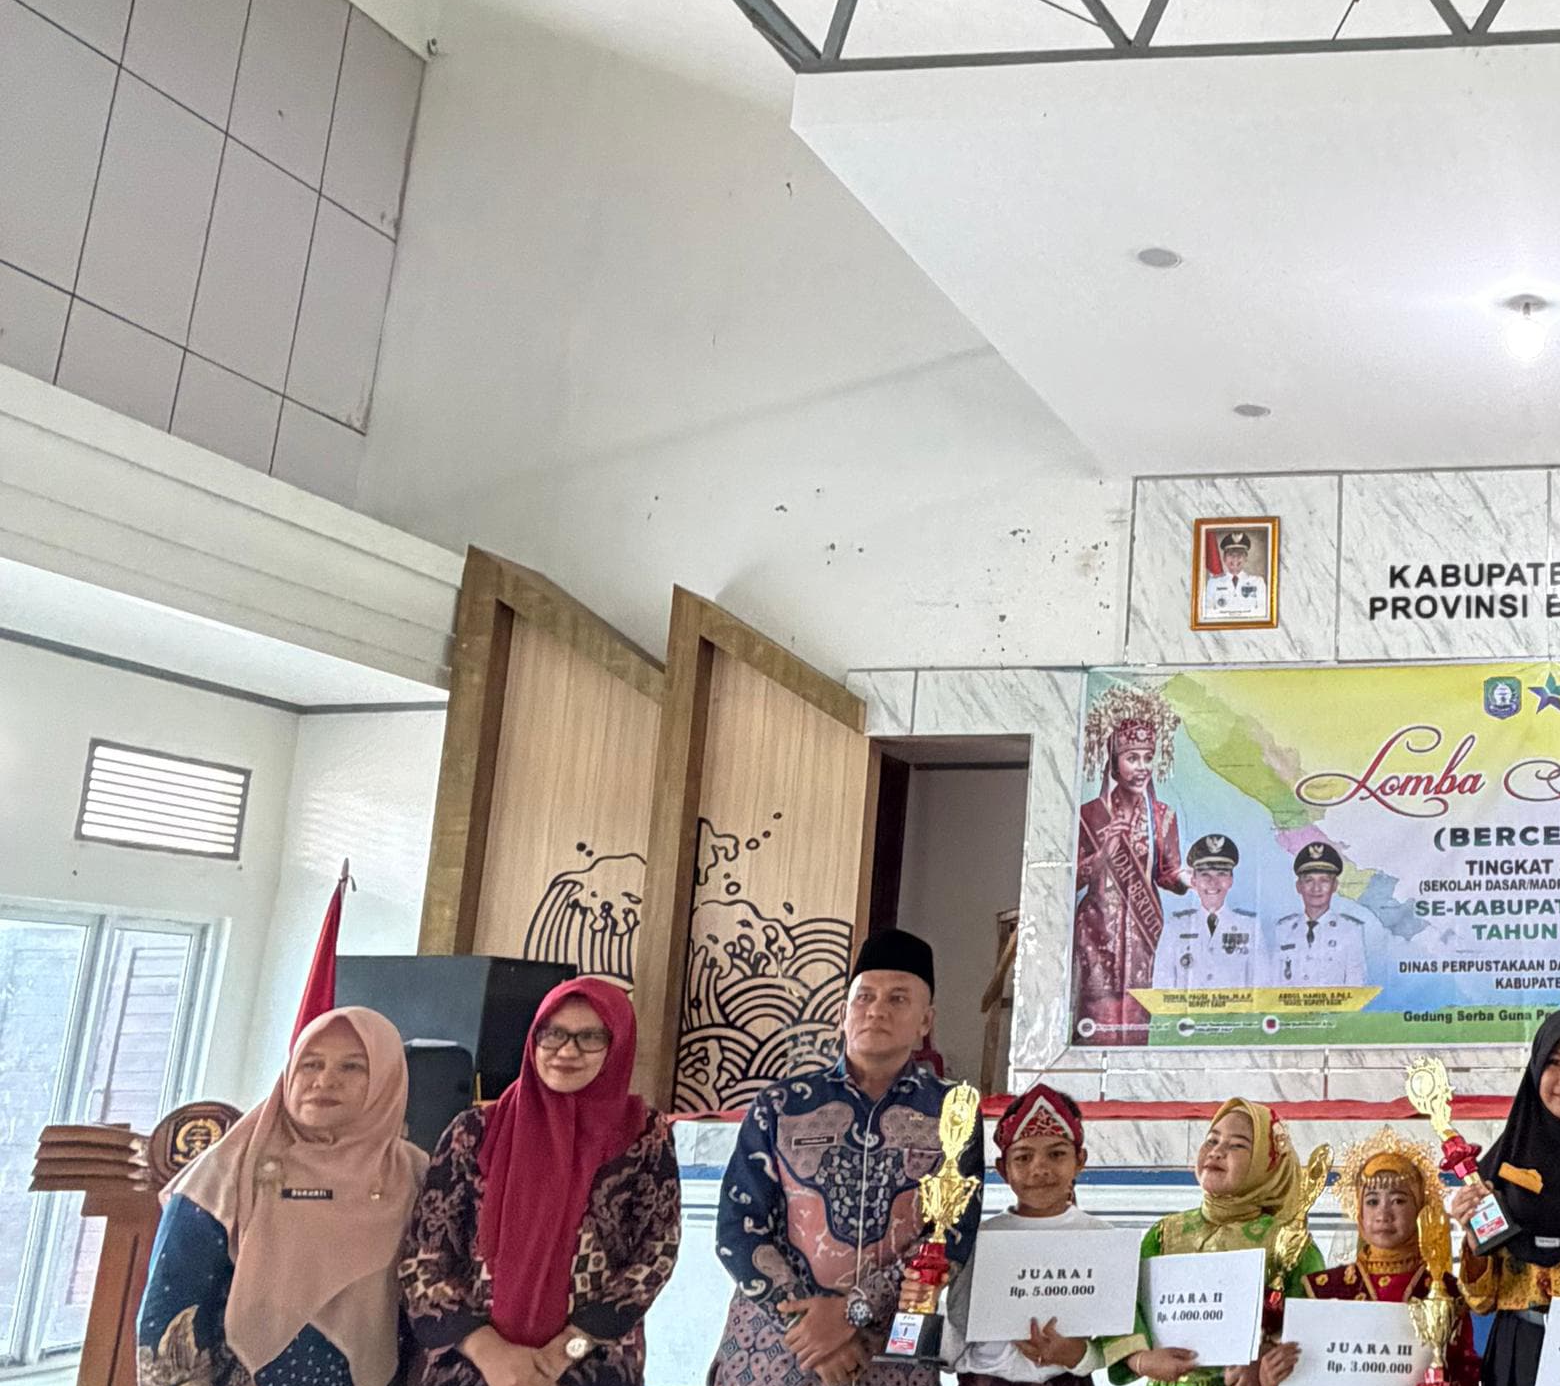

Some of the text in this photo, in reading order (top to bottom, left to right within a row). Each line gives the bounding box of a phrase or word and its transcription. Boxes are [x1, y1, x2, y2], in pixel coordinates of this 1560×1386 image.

[1369, 594, 1529, 621] PROVINSI
[1296, 726, 1486, 818] Lomba
[1465, 859, 1554, 876] TINGKAT
[1419, 879, 1482, 895] (SEKOLAH
[1472, 923, 1558, 940] TAHUN
[1399, 960, 1438, 973] DINAS
[1442, 959, 1545, 973] PERPUSTAKAAN
[1403, 1010, 1453, 1024] Gedung
[1457, 1009, 1494, 1022] Serba
[1499, 1009, 1532, 1021] Guna
[1017, 1268, 1093, 1280] JUARA I
[1009, 1285, 1095, 1299] Rp. 5.000.000
[1159, 1292, 1223, 1305] JUARA II
[1157, 1309, 1224, 1324] Rp. 4.000.000
[1326, 1342, 1413, 1356] JUARA III
[1327, 1360, 1413, 1374] Rp. 3.000.000
